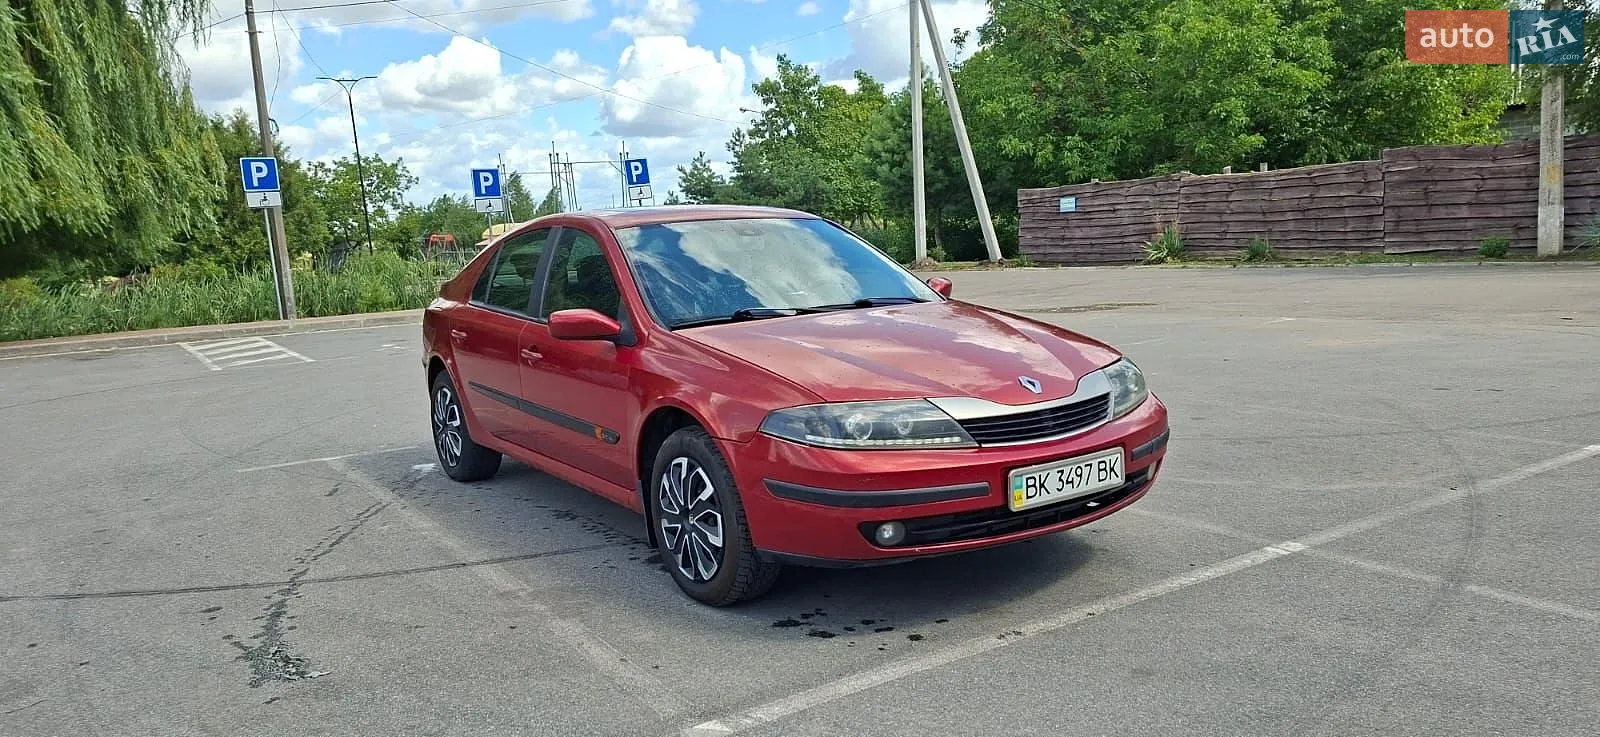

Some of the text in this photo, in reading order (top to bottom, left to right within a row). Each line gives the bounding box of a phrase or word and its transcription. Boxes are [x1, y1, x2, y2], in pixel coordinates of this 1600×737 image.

[250, 161, 268, 187] P
[631, 161, 643, 182] P
[479, 172, 493, 194] P
[1025, 456, 1120, 499] BK 3497 BK
[1014, 494, 1023, 502] UA
